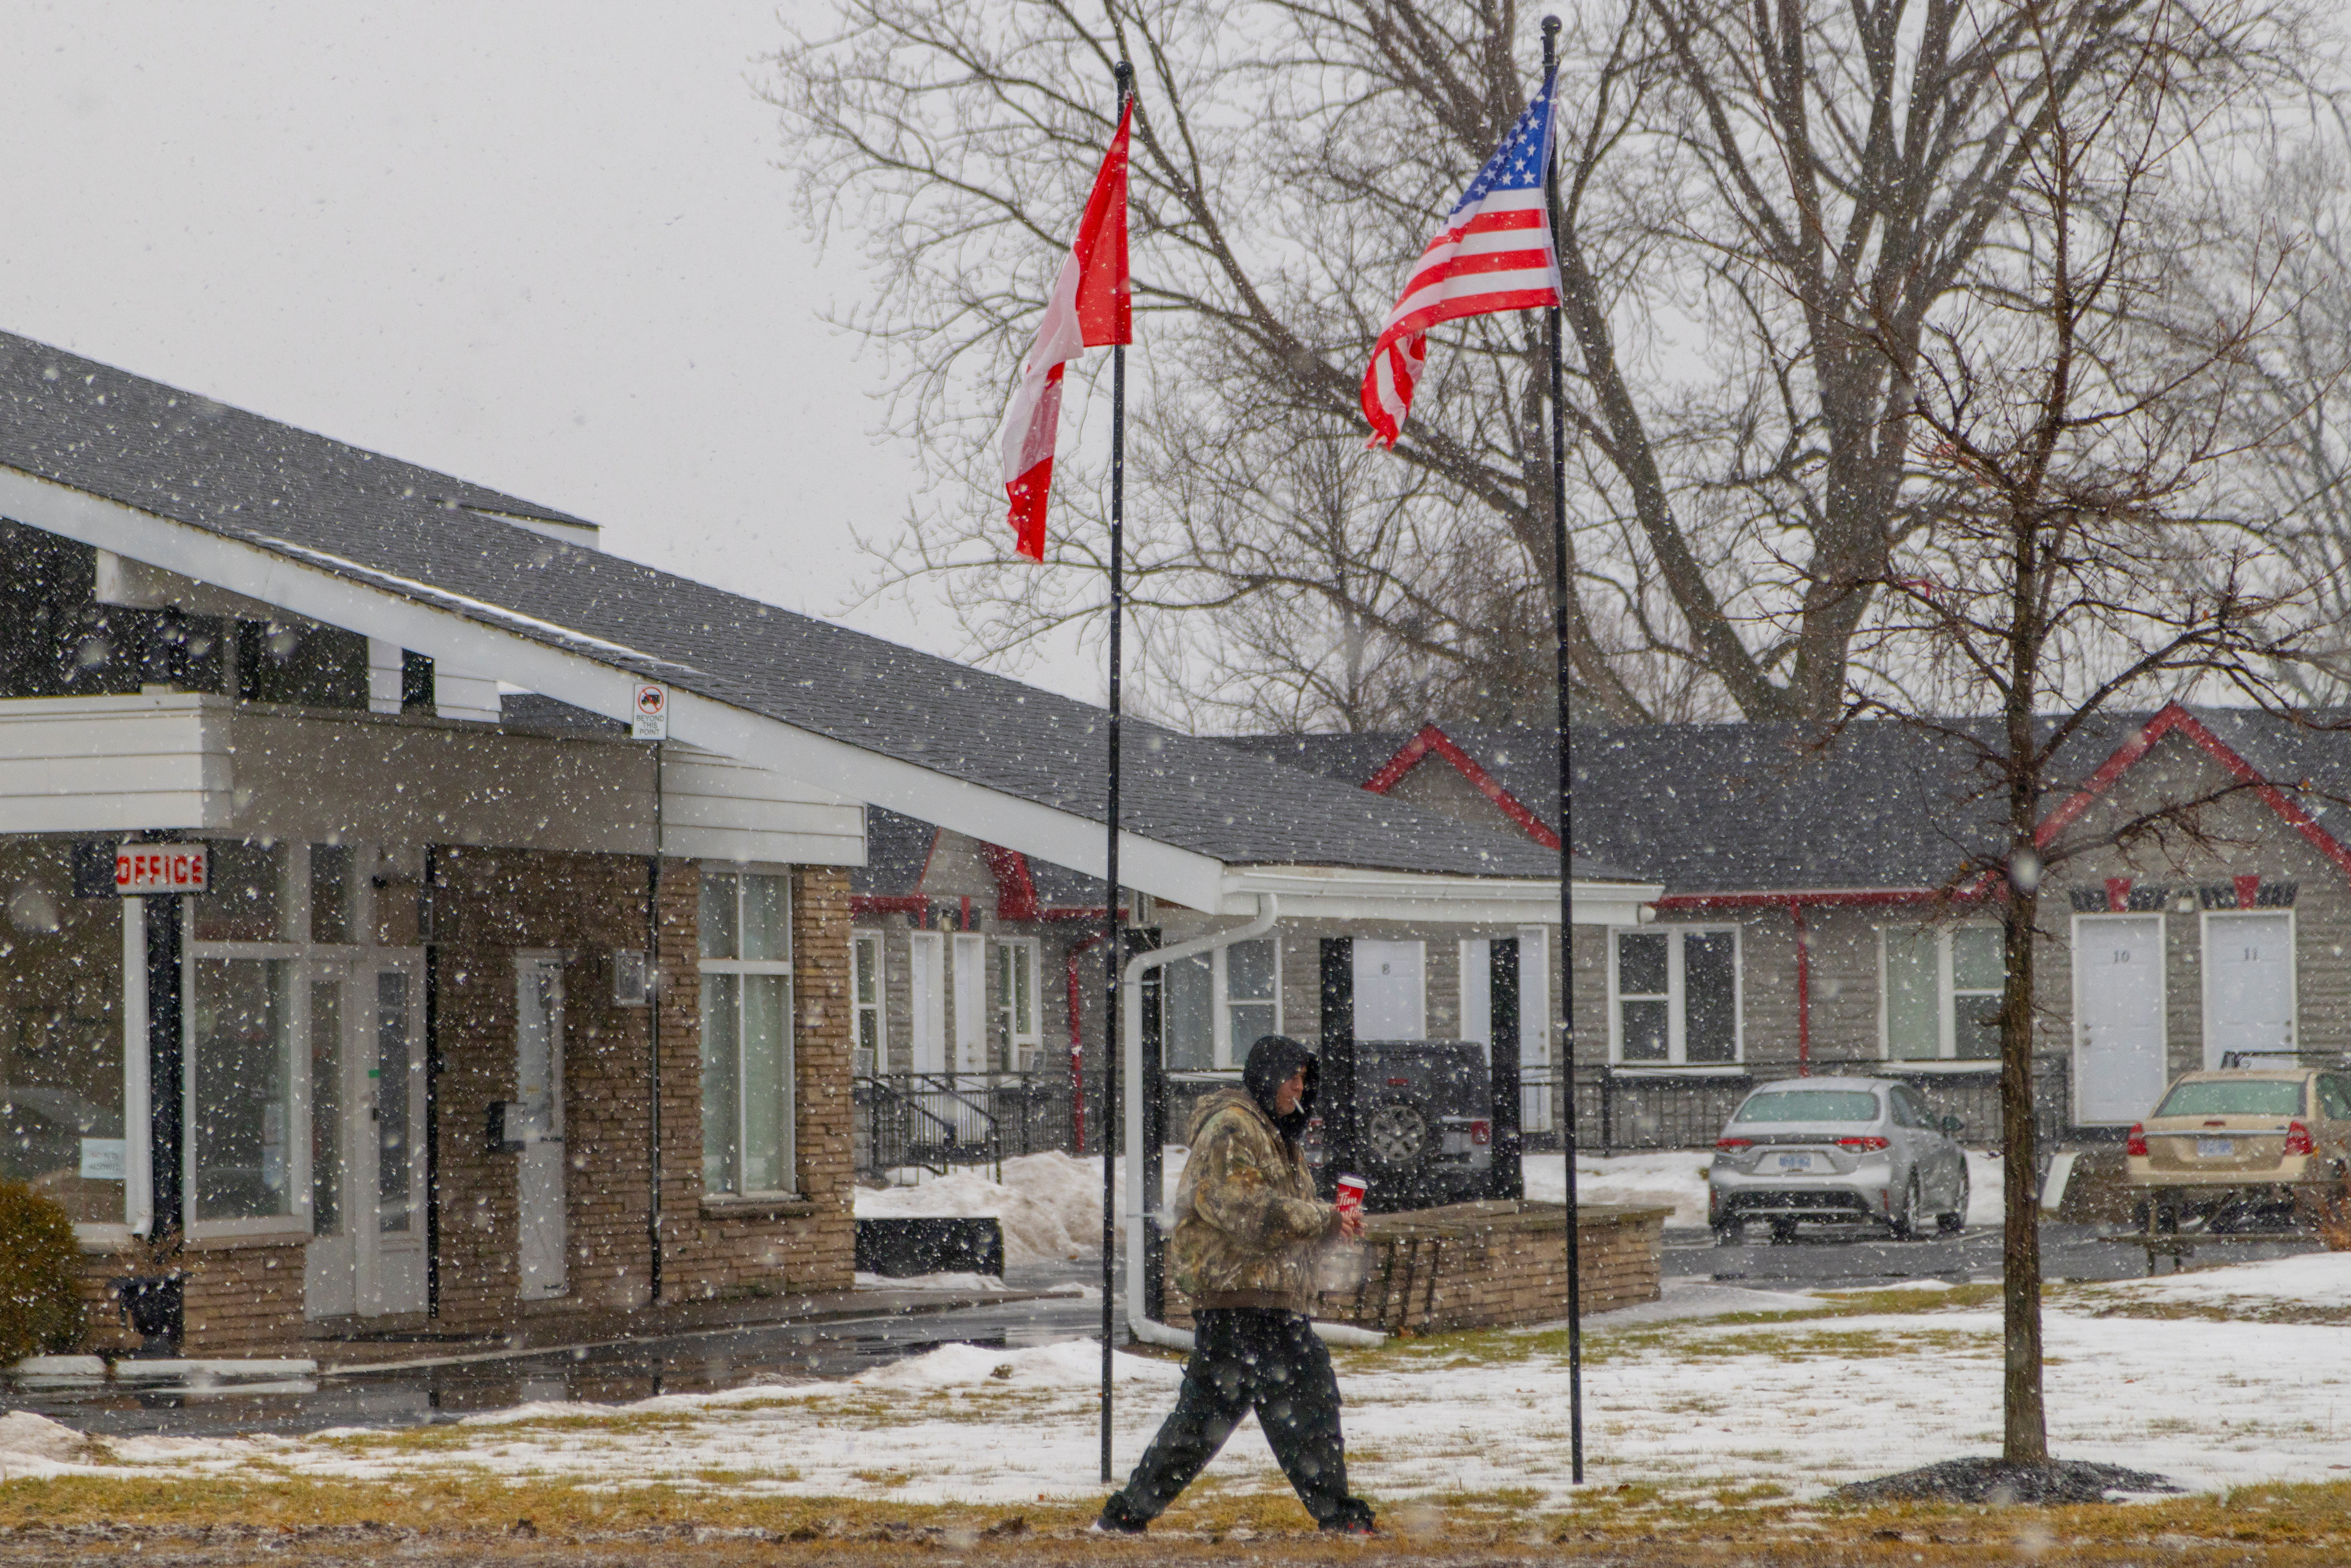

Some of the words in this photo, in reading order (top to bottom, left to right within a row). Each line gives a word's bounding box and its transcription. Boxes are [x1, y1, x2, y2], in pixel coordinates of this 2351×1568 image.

[117, 855, 203, 885] OFFICE
[2113, 950, 2130, 964] 10
[1382, 963, 1390, 976] 8
[1339, 1191, 1357, 1206] Tim
